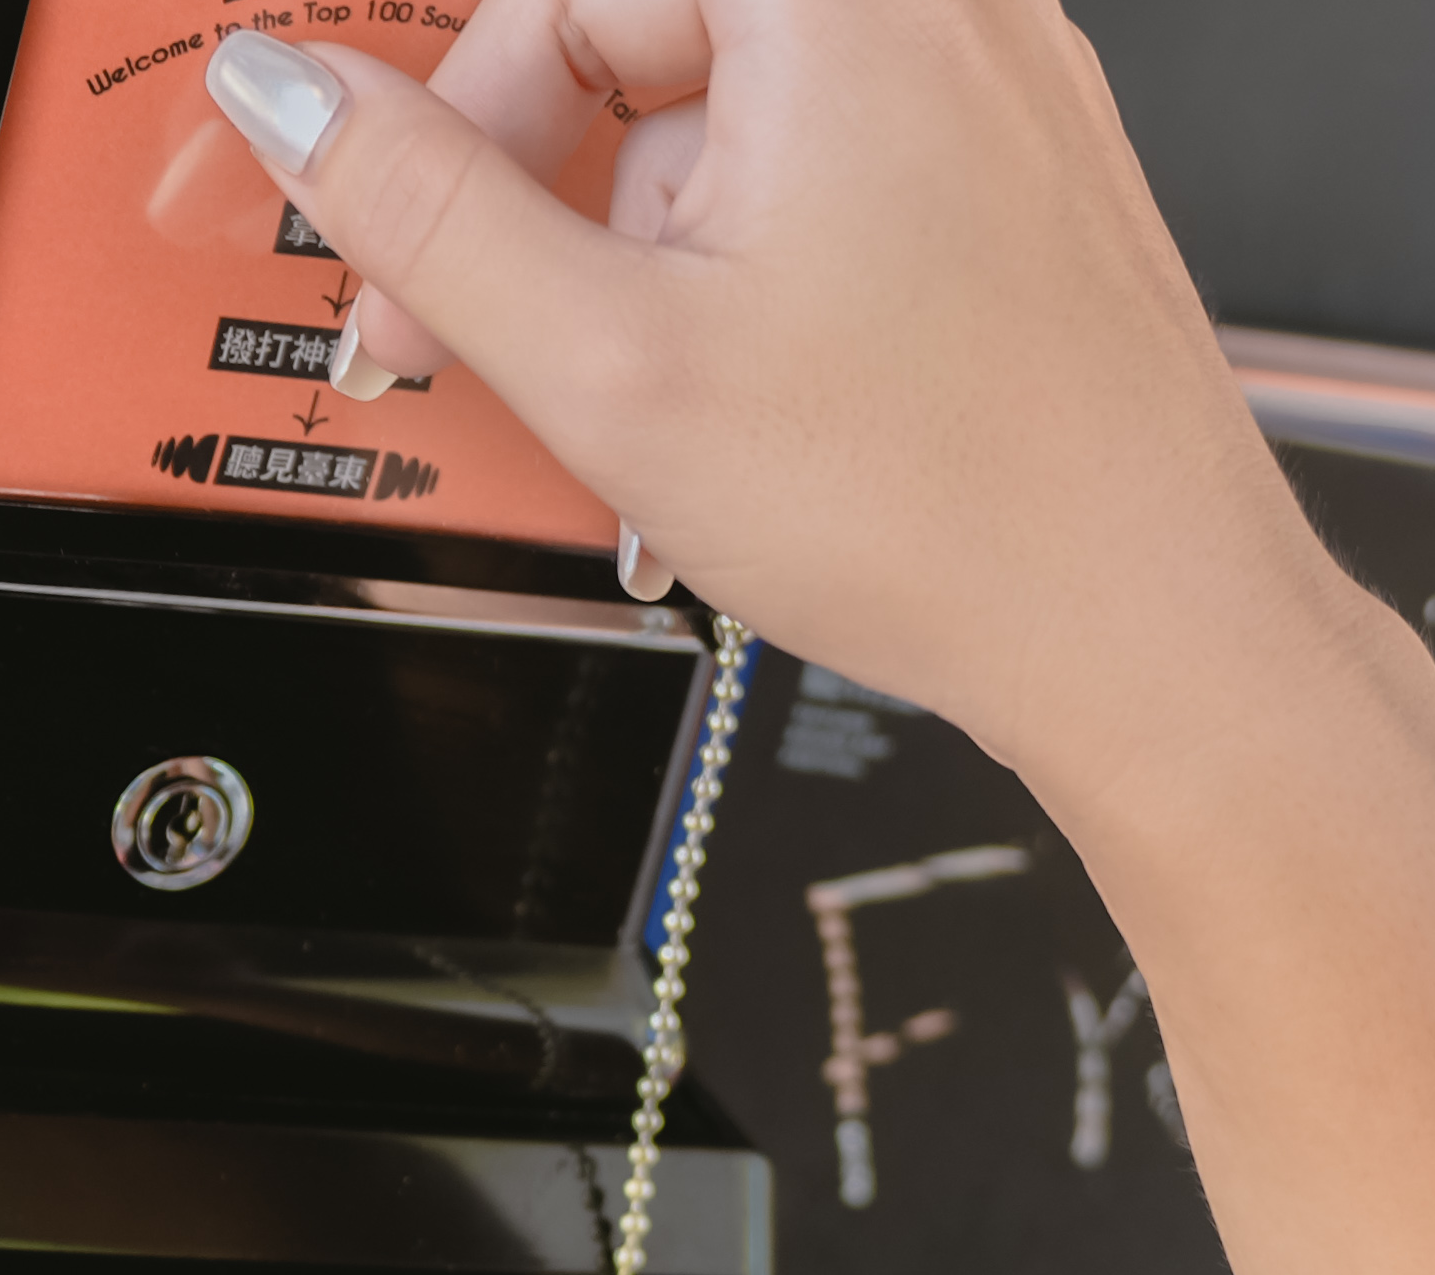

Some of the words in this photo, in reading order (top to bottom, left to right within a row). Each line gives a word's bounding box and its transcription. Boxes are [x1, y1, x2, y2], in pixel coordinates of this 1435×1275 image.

[86, 32, 205, 97] Welcome
[251, 9, 294, 31] the
[303, 1, 352, 28] Top
[367, 0, 414, 24] 100
[420, 5, 468, 34] Sou
[223, 444, 368, 491] 聽見臺東
